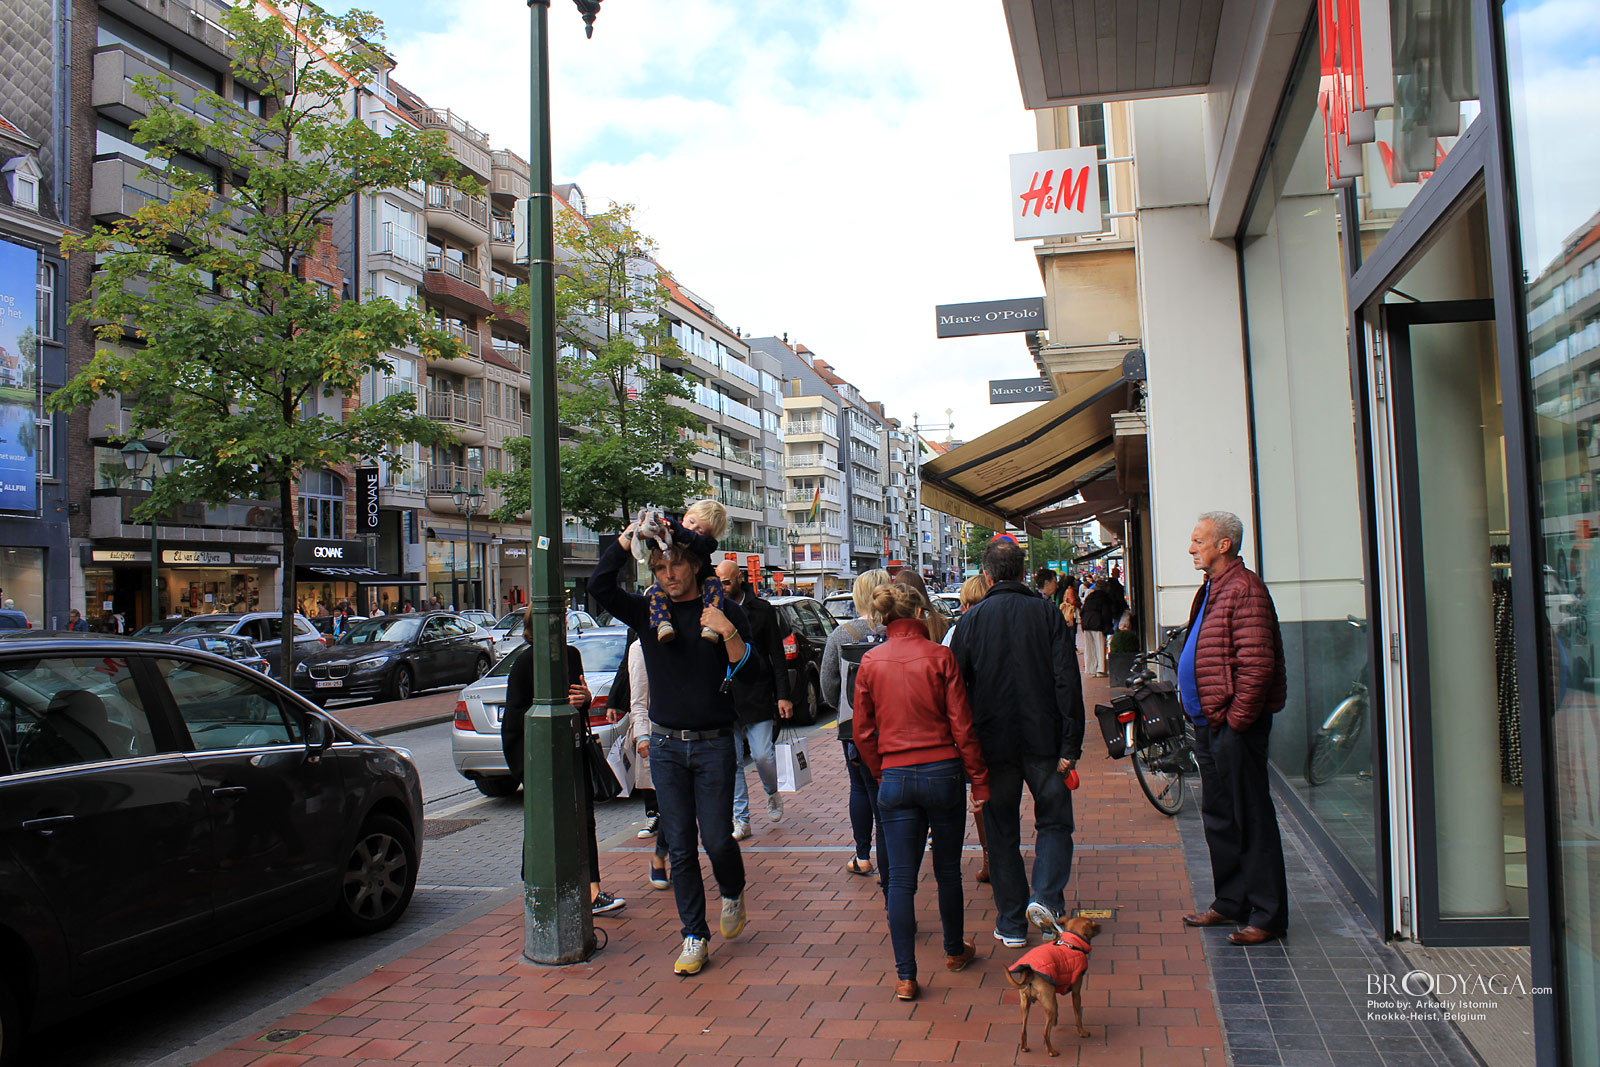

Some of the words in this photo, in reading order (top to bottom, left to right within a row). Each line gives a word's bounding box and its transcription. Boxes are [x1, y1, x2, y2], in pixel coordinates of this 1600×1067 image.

[1020, 166, 1089, 217] H&M
[8, 307, 22, 319] het
[940, 315, 981, 325] Marc
[985, 309, 1038, 321] O'Polo
[992, 387, 1022, 396] Marc
[1024, 385, 1046, 393] O'P
[4, 484, 26, 492] ALLFIN
[368, 474, 379, 527] GIOVANE
[314, 546, 343, 558] GIOVANE
